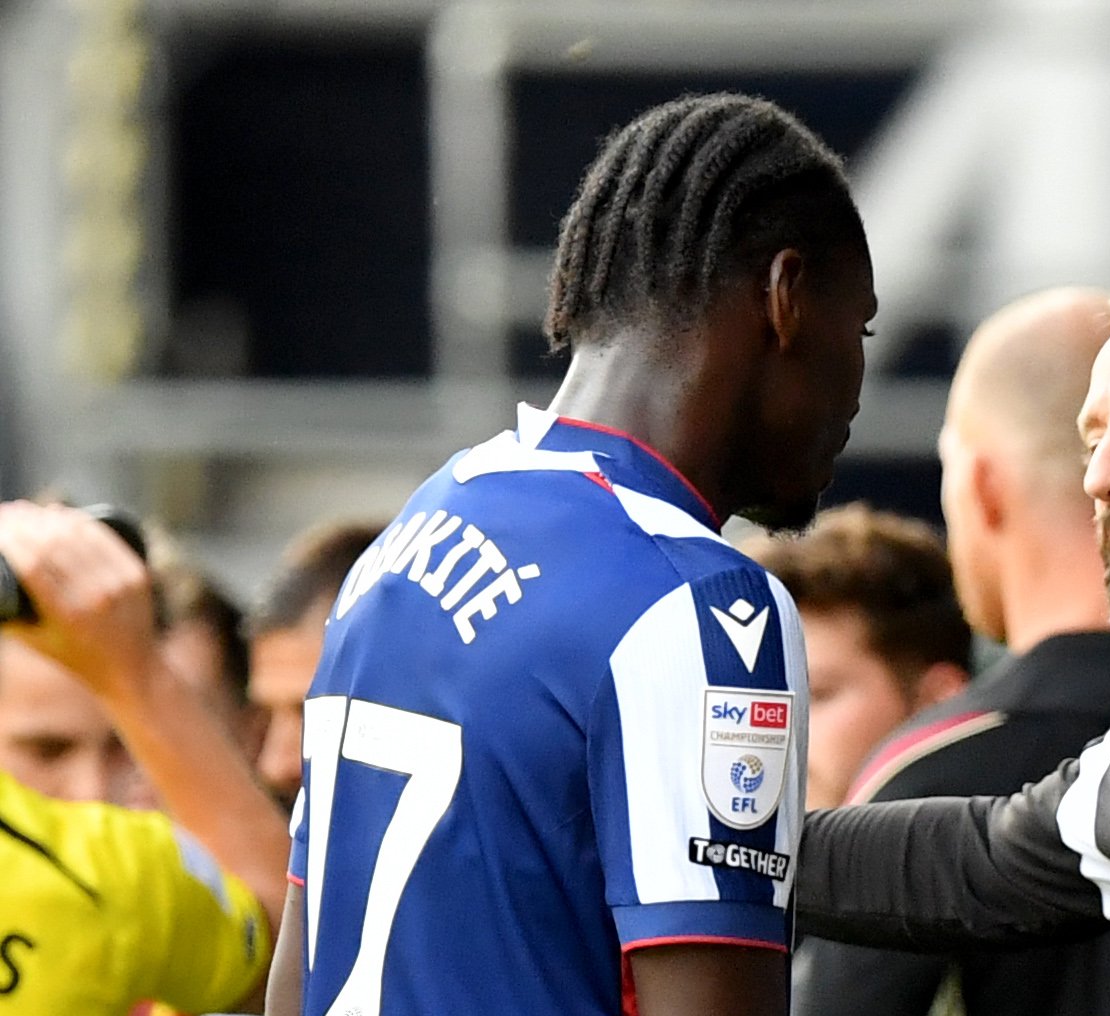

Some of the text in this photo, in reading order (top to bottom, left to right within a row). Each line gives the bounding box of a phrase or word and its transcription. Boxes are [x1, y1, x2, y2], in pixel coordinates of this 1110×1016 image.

[711, 701, 784, 725] sky bet
[731, 797, 757, 814] EFL
